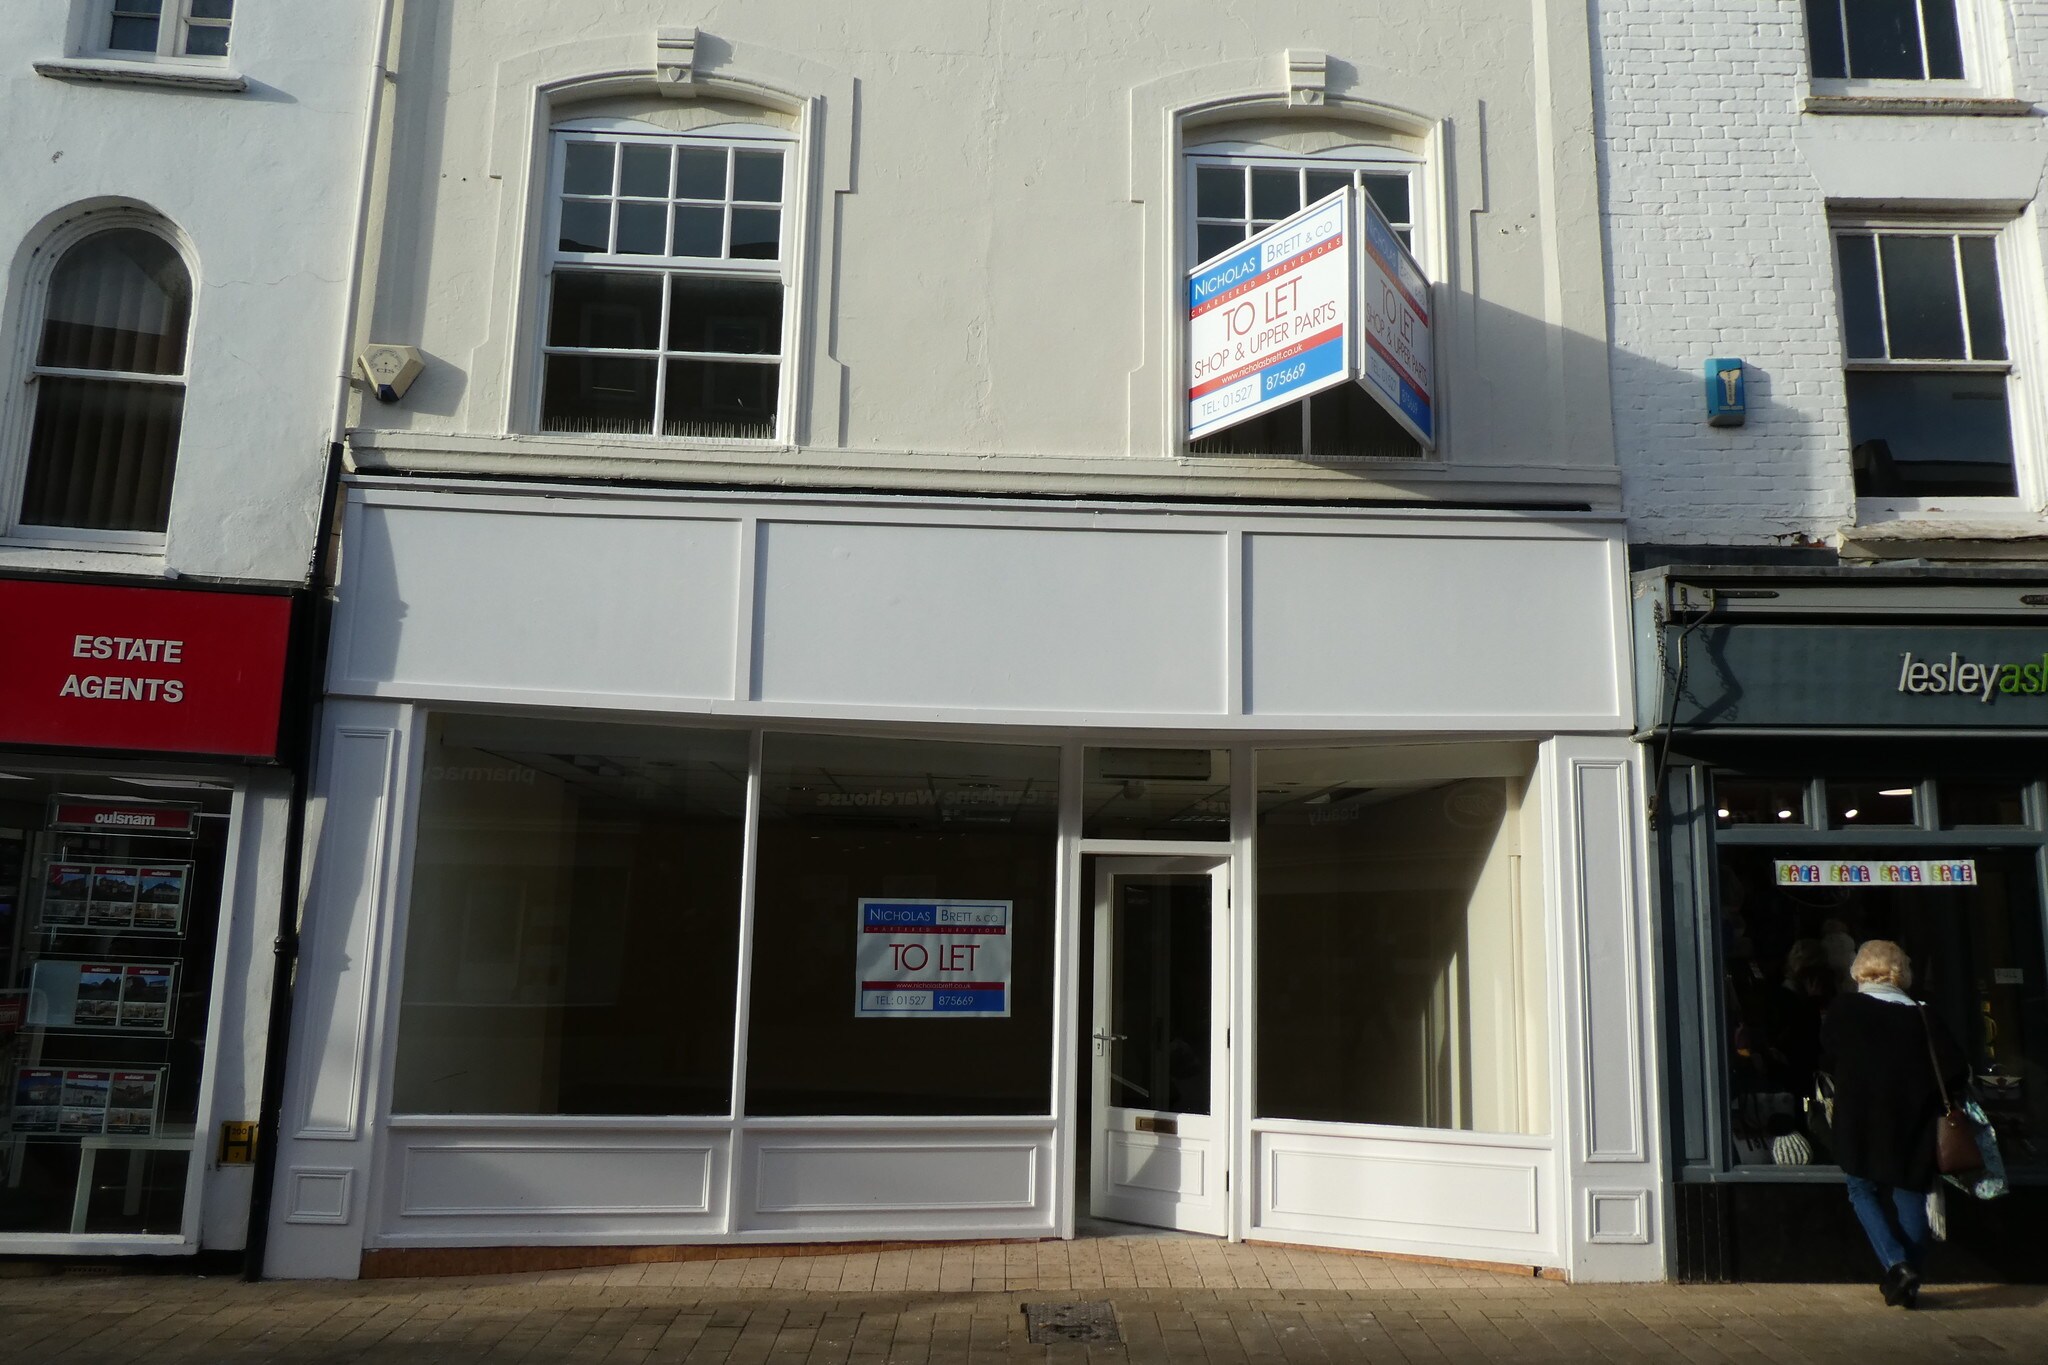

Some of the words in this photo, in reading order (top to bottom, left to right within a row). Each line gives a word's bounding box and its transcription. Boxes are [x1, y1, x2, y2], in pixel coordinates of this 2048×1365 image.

[1195, 257, 1256, 300] NICHOLAS
[1267, 232, 1302, 264] BRETT
[1304, 232, 1313, 244] &
[1316, 221, 1333, 238] CO
[1191, 280, 1256, 317] CHARTERED
[1266, 237, 1341, 280] SURVEYORS
[1222, 301, 1256, 341] TO
[1265, 275, 1303, 324] LET
[1380, 279, 1396, 325] TO
[1399, 303, 1415, 348] LET
[1194, 349, 1230, 380] SHOP
[1235, 342, 1245, 361] &
[1250, 321, 1289, 354] UPPER
[1294, 300, 1336, 336] PARTS
[1221, 343, 1303, 384] www.nicholasbrett.co.uk
[1202, 399, 1220, 417] TEL:
[1223, 384, 1253, 409] 01527
[1266, 362, 1306, 391] 875669
[73, 634, 184, 664] ESTATE
[59, 674, 184, 703] AGENTS
[94, 811, 156, 826] oulsnam
[1780, 866, 1820, 882] SALE
[1831, 867, 1870, 882] SALE
[1880, 867, 1921, 882] SALE
[1930, 866, 1972, 882] SALE
[870, 909, 931, 922] NICHOLAS
[941, 909, 972, 922] BRETT
[975, 914, 982, 922] &
[984, 914, 998, 923] CO
[889, 943, 929, 971] TO
[939, 944, 981, 971] LET
[875, 995, 894, 1006] TEL:
[896, 995, 927, 1006] 01527
[938, 995, 974, 1006] 875669
[896, 982, 971, 990] www.nicholasbrett.co.uk
